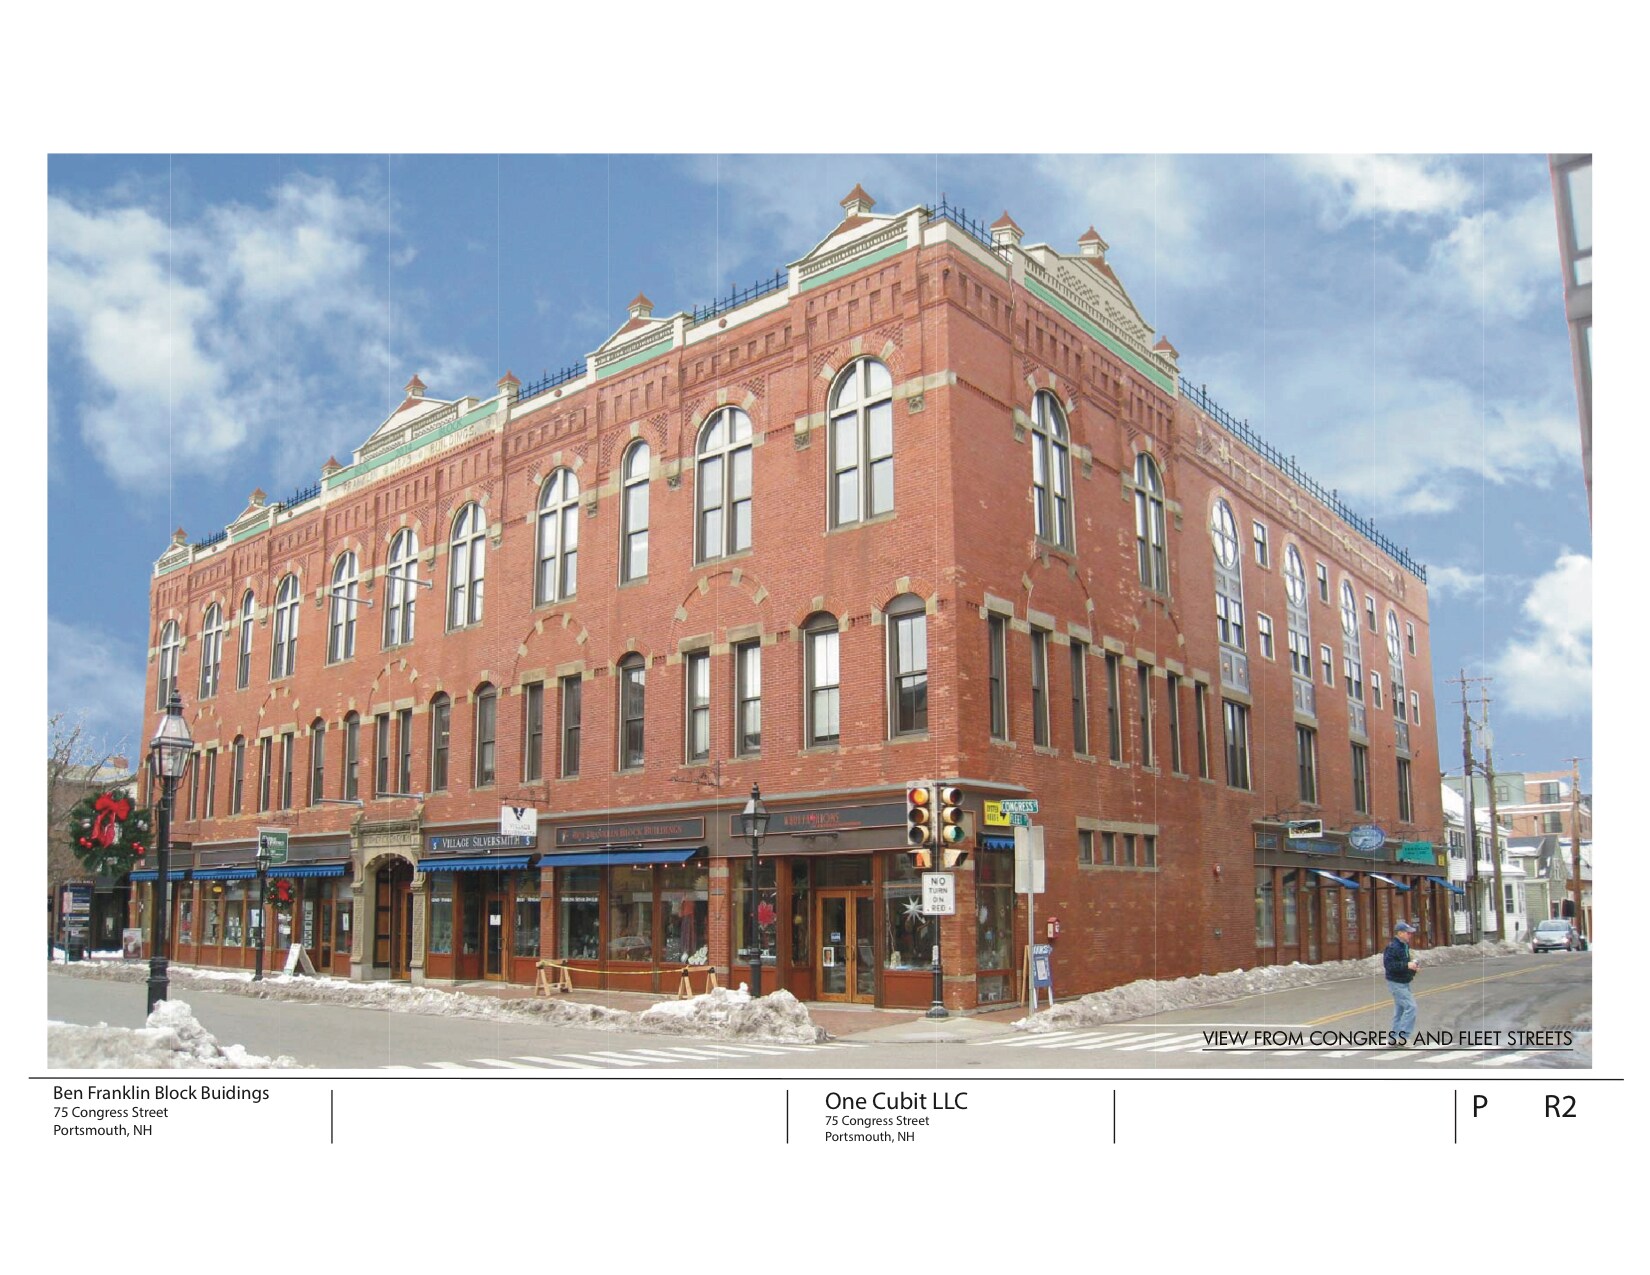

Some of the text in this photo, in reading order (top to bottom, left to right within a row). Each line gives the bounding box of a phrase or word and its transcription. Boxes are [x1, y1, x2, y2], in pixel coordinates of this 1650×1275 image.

[1002, 801, 1033, 812] CONGRESS
[643, 825, 683, 836] BUILDINGS
[442, 837, 470, 849] VILLAGE
[472, 835, 520, 848] SILVERSMITH
[931, 877, 946, 886] NO
[931, 904, 946, 912] RED
